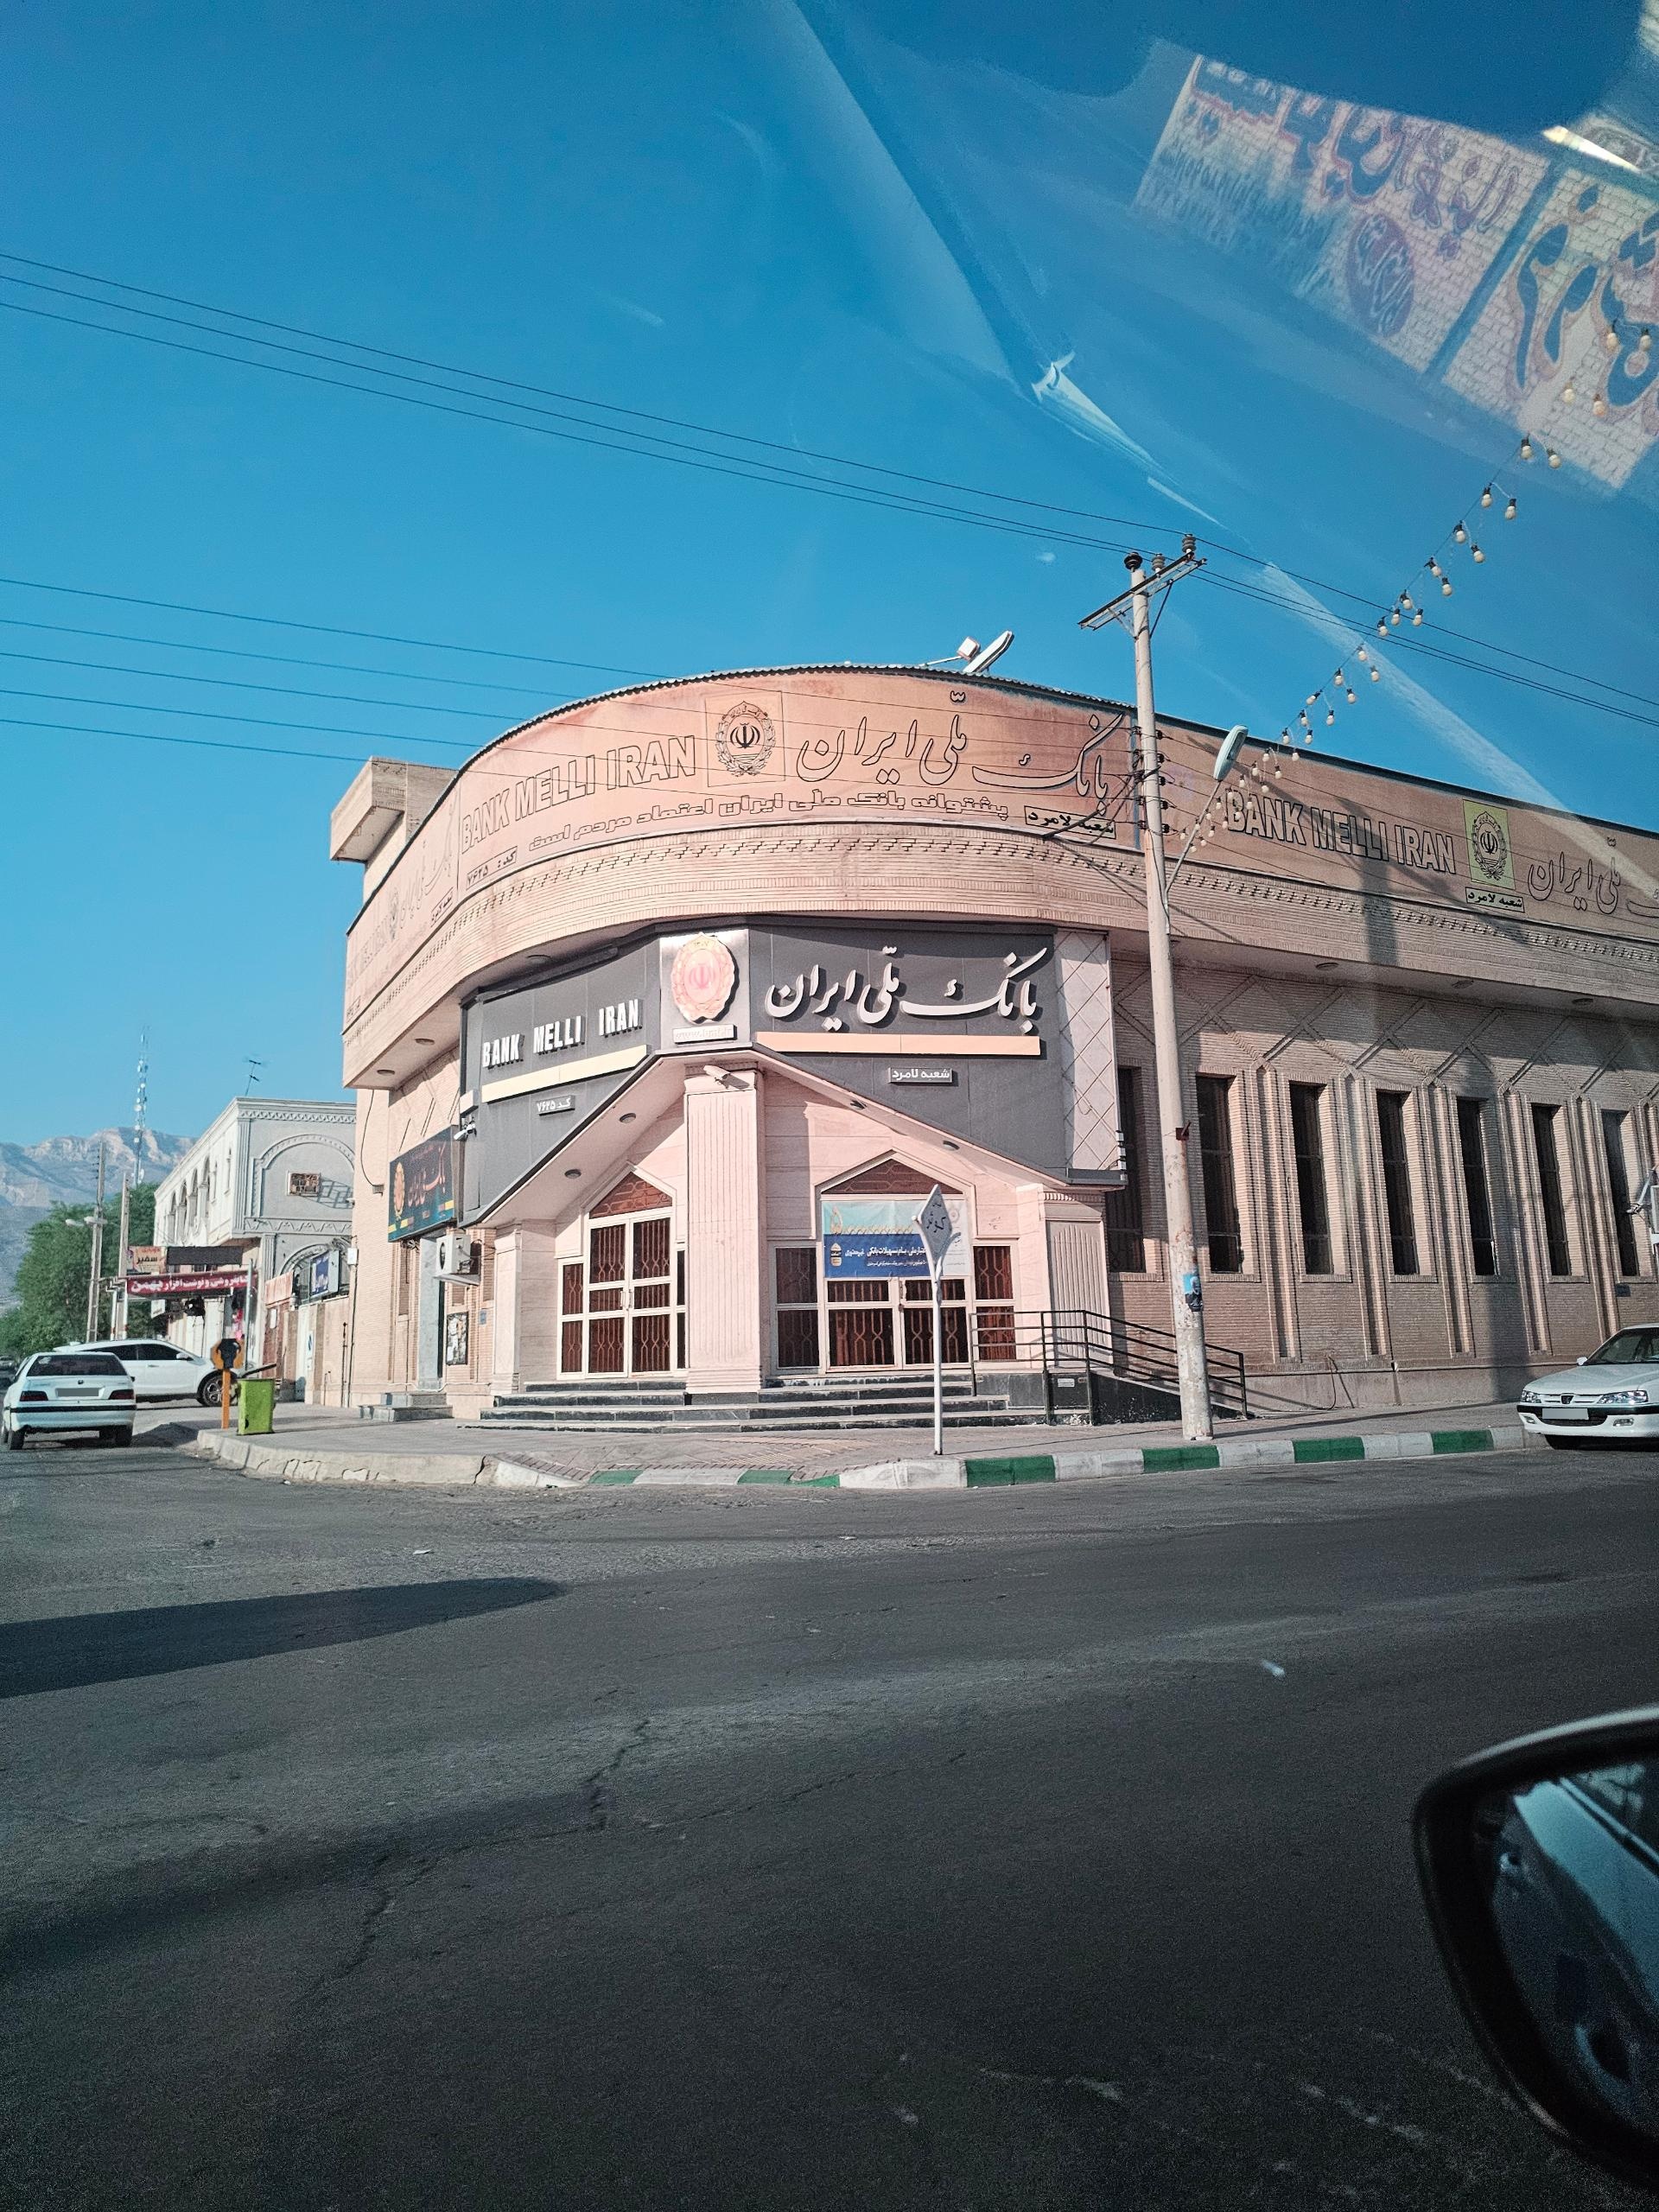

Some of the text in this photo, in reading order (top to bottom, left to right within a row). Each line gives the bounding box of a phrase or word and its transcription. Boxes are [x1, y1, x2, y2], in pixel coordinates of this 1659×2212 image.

[795, 715, 918, 785] ایران
[973, 712, 1123, 817] بانک
[461, 734, 696, 855] BANK MELLI IRAN
[718, 792, 784, 817] ایران
[847, 790, 906, 810] بانک
[911, 792, 1008, 820] پشتوانه
[636, 798, 714, 823] اعتماد
[1027, 810, 1073, 830] لامرد
[528, 823, 572, 851] است
[573, 816, 632, 841] مردم
[1225, 790, 1457, 874] BANK MELLI IRAN
[1527, 851, 1592, 912] ایران
[1468, 893, 1522, 908] شعبه لامرد
[764, 963, 857, 1033] ایران
[899, 947, 1048, 1035] بانک
[482, 998, 639, 1069] BANK MELLI IRAN
[891, 1069, 951, 1081] شعبه لامرد
[536, 1096, 572, 1112] کد ۷۶۲۵
[130, 1279, 163, 1294] بهمن
